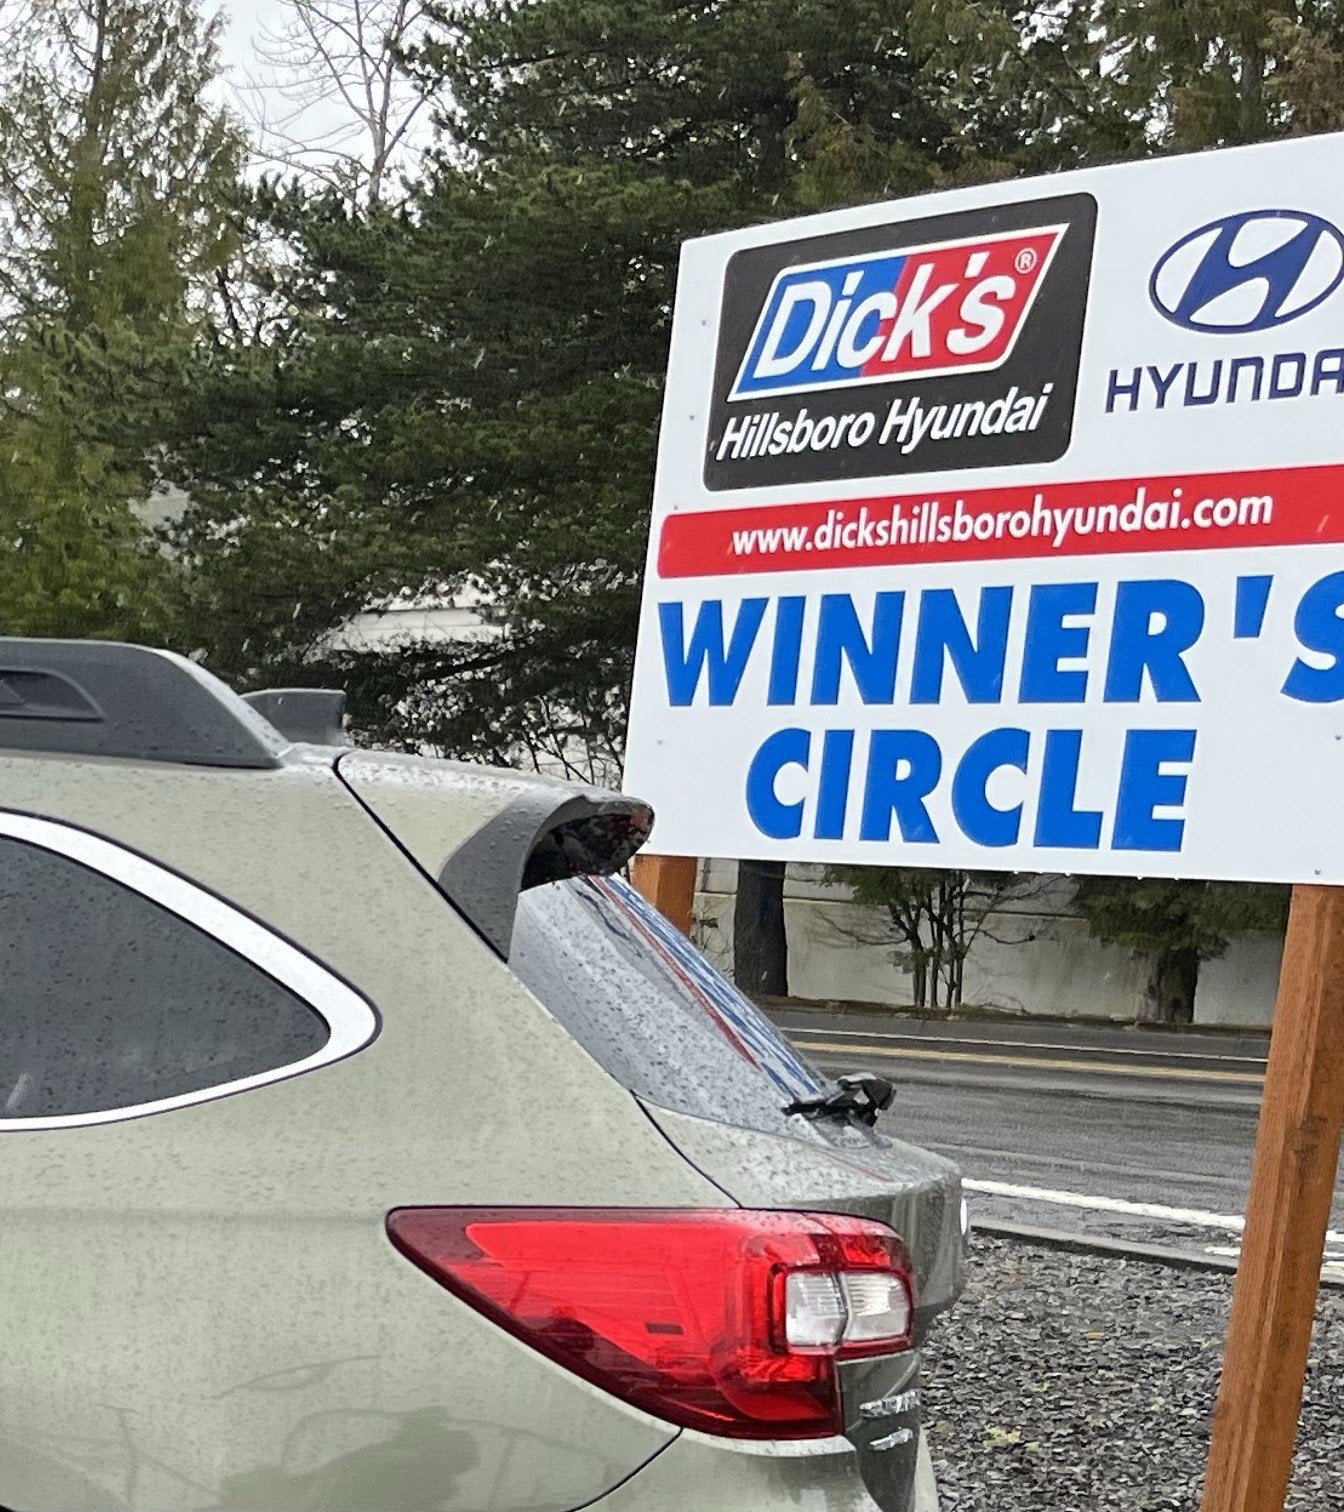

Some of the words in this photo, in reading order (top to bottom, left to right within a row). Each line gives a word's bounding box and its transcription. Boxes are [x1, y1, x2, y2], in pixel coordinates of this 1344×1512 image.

[715, 409, 876, 462] Hillsboro
[878, 382, 1054, 454] Hyundai
[732, 486, 1275, 557] www.dickshillsborohyundai.com
[657, 570, 1344, 708] WINNER'S
[745, 726, 1198, 853] CIRCLE
